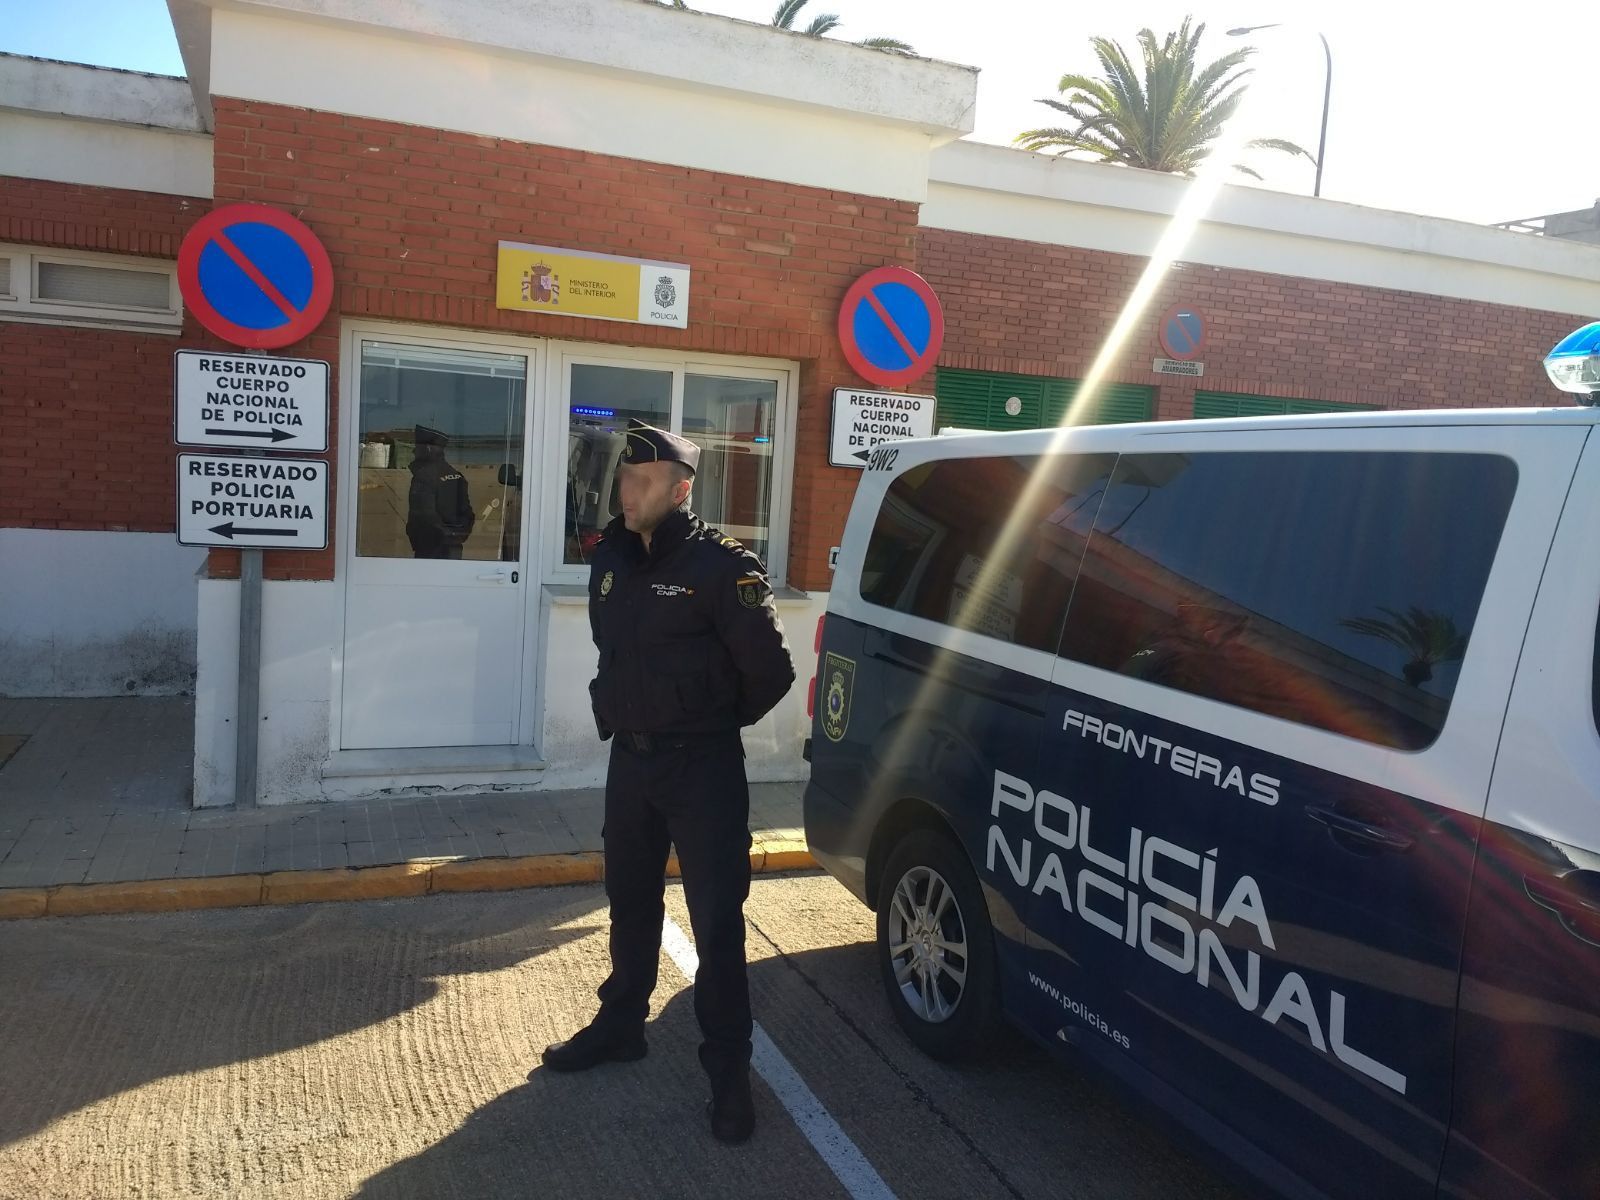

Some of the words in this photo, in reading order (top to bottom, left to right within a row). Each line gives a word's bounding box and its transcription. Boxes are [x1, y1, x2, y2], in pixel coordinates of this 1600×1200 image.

[569, 279, 608, 289] MINISTERIO
[569, 287, 581, 295] DEL
[584, 289, 616, 298] INTERIOR
[199, 358, 306, 379] RESERVADO
[216, 376, 290, 393] CUERPO
[206, 392, 299, 410] NACIONAL
[850, 395, 921, 411] RESERVADO
[201, 408, 225, 422] DE
[233, 410, 303, 426] POLICIA
[860, 409, 909, 423] CUERPO
[853, 422, 914, 437] NACIONAL
[849, 435, 864, 445] DE
[868, 449, 899, 471] 9W2
[189, 461, 317, 482] RESERVADO
[211, 481, 296, 500] POLICIA
[191, 500, 314, 520] PORTUARIA
[651, 583, 687, 593] POLICIA
[1062, 709, 1281, 806] FRONTERAS
[990, 769, 1276, 951] POLICÍA
[986, 824, 1407, 1095] NACIONAL
[1028, 971, 1130, 1049] www.policia.es
